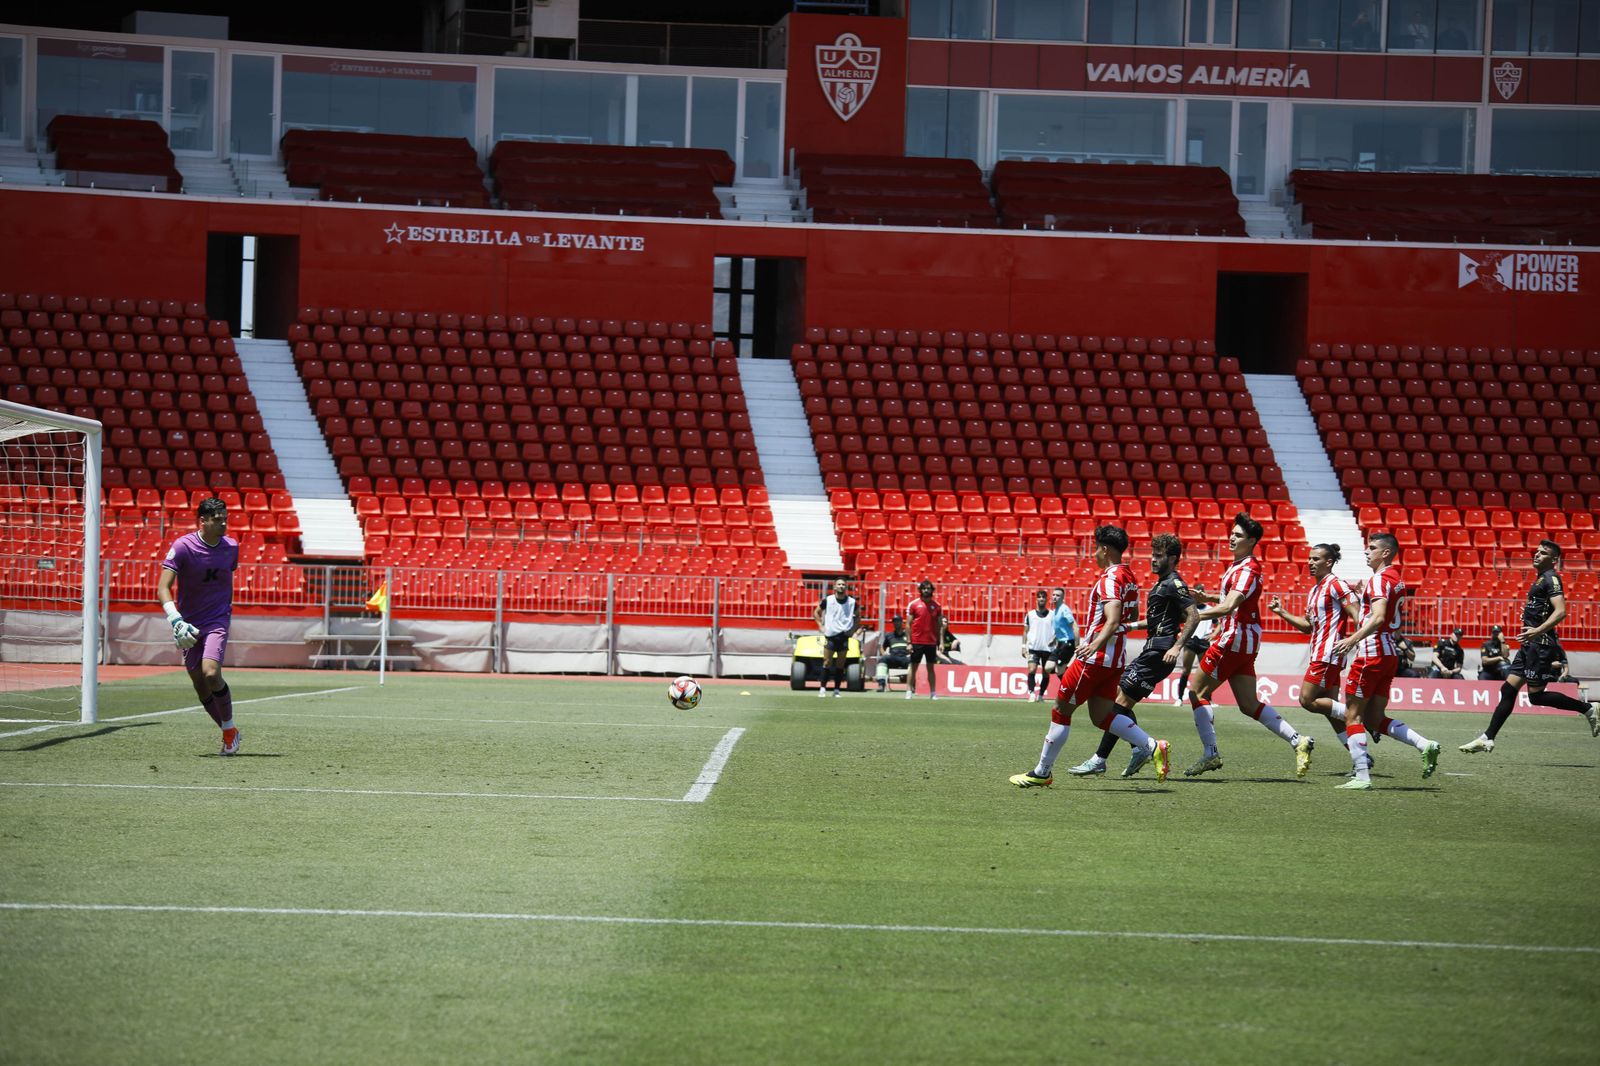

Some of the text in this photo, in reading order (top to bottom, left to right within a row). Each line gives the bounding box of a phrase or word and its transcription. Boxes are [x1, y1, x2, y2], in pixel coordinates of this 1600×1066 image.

[823, 51, 872, 63] U D
[1086, 63, 1310, 88] VAMOS ALMERÍA
[407, 226, 645, 251] ESTRELLA DE LEVANTE
[1515, 253, 1579, 273] POWER
[1515, 272, 1579, 292] HORSE
